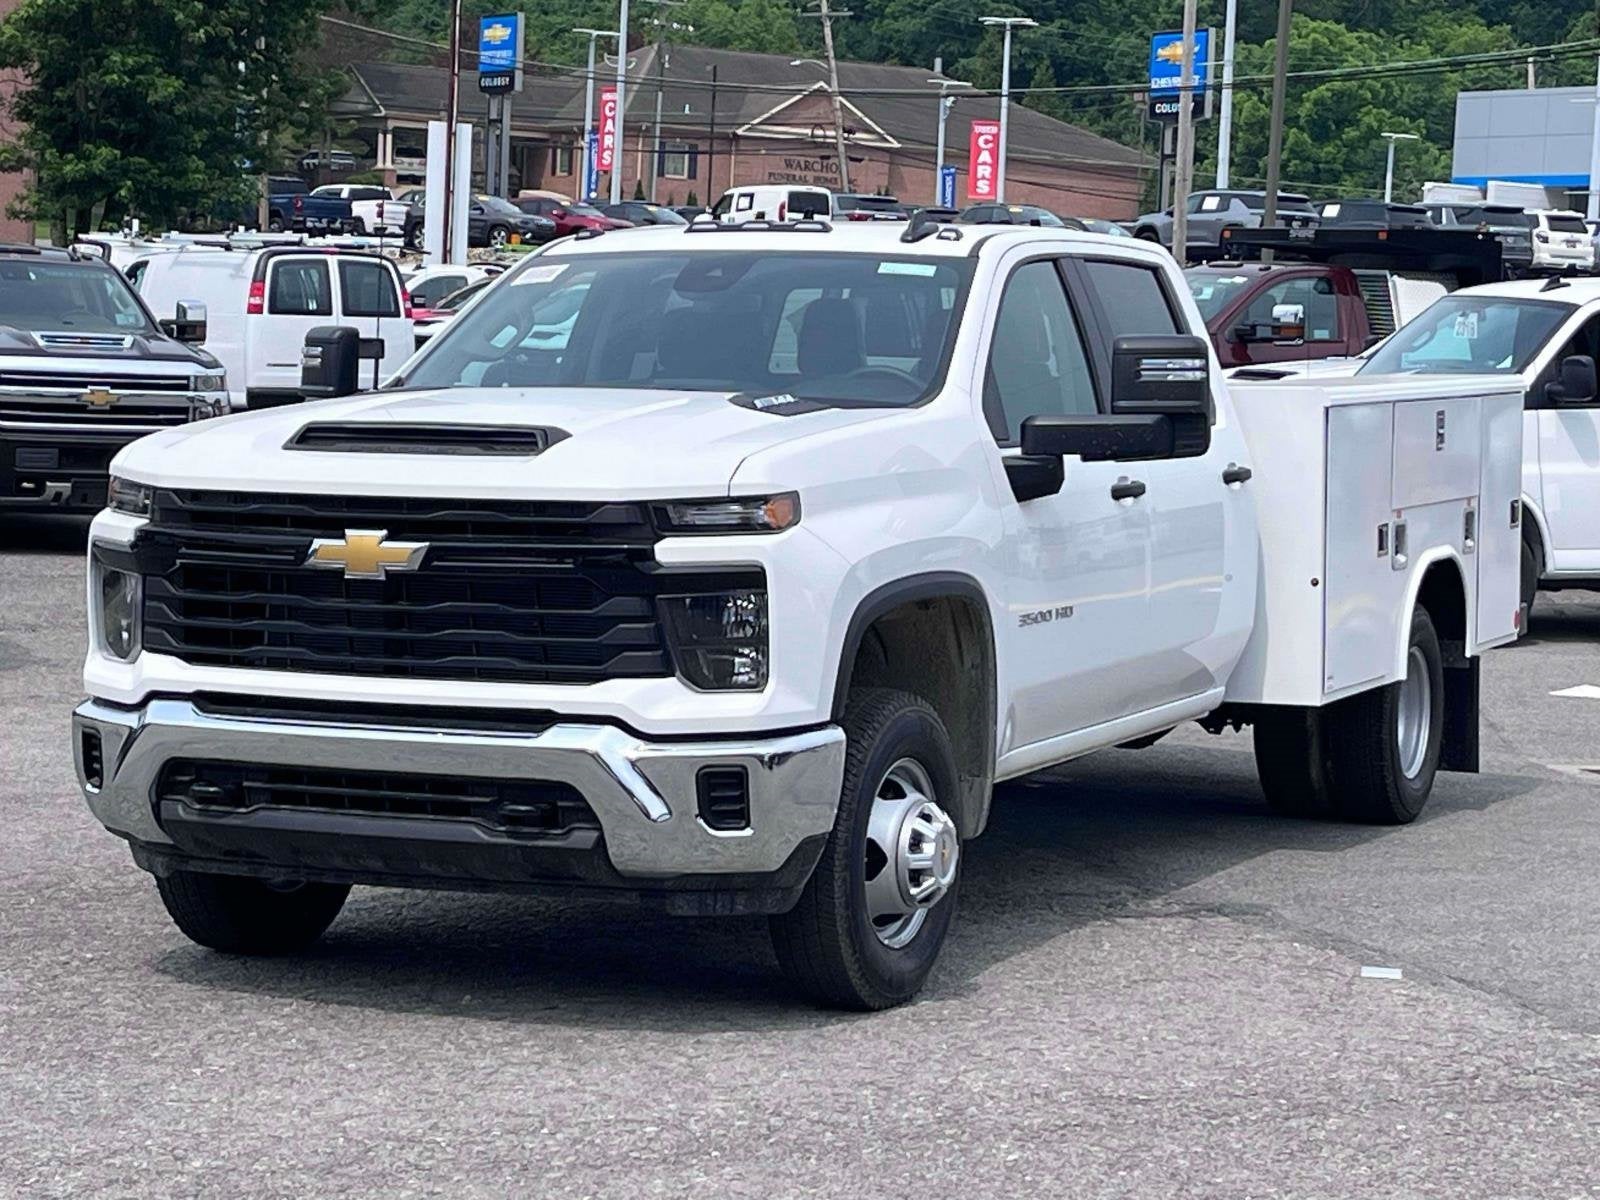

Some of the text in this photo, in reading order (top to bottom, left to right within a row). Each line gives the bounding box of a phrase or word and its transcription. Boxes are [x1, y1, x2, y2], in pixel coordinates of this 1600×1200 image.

[601, 101, 615, 166] CARS
[784, 159, 841, 174] WARCHO
[975, 134, 995, 194] CARS
[1018, 606, 1073, 627] 3500 HD
